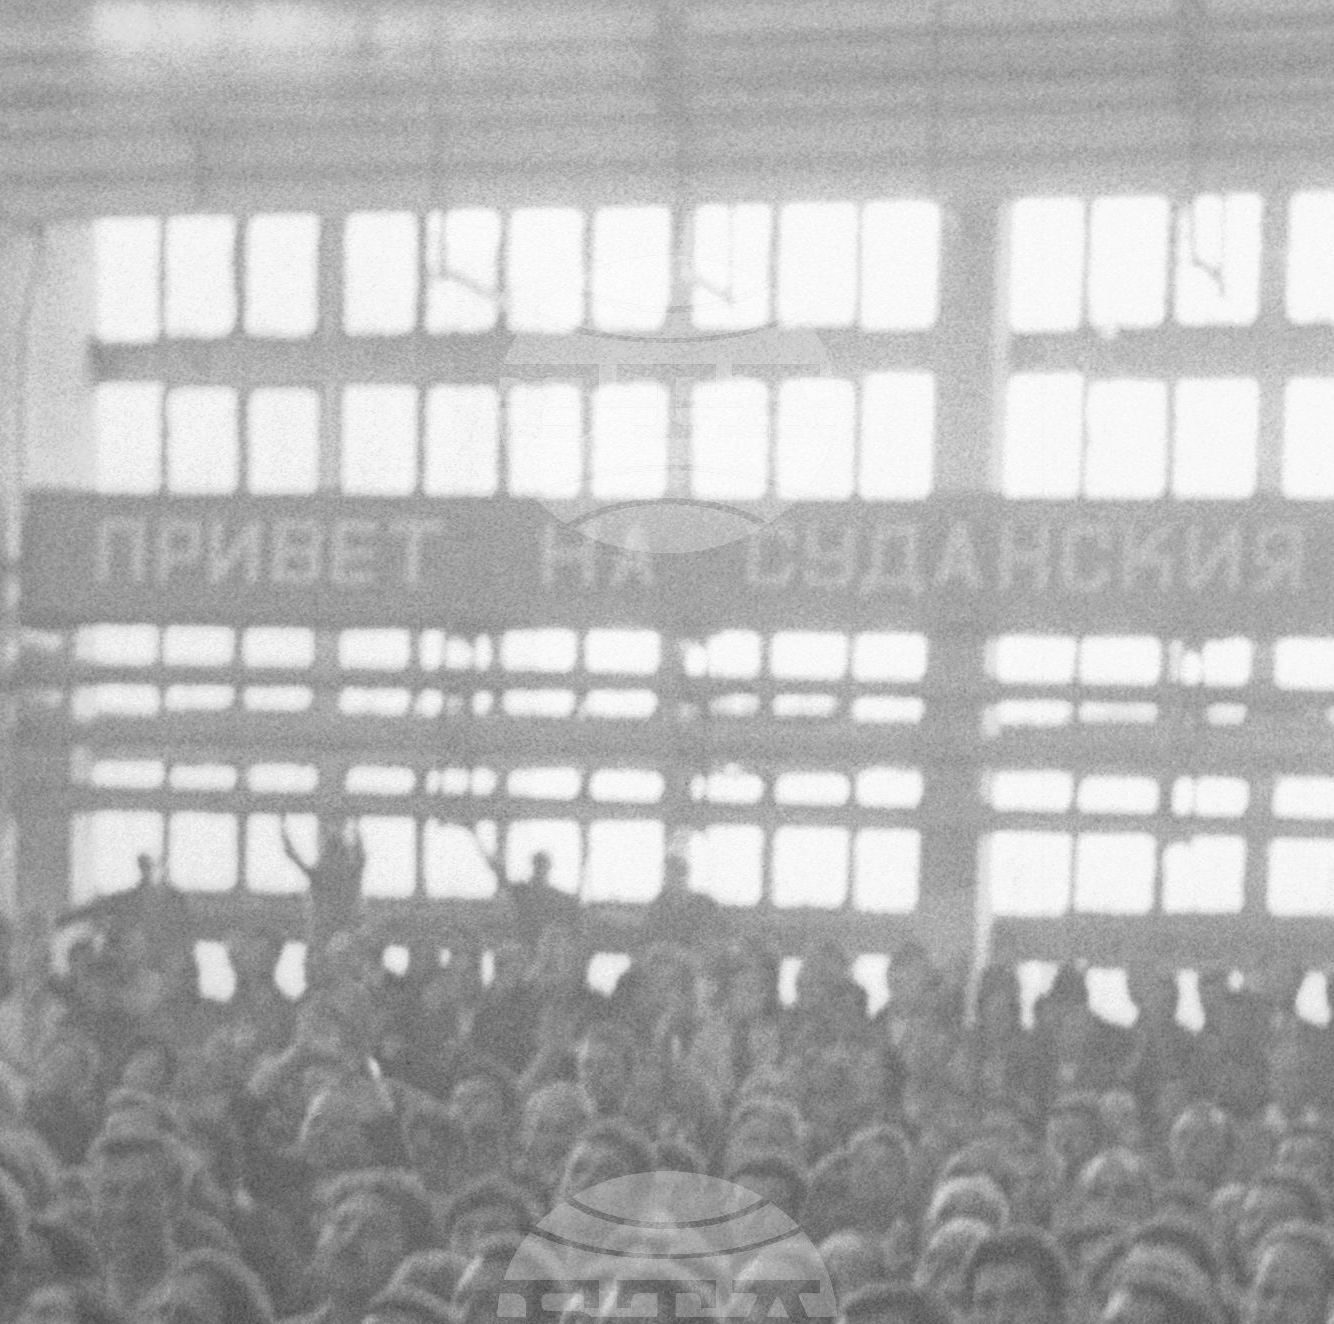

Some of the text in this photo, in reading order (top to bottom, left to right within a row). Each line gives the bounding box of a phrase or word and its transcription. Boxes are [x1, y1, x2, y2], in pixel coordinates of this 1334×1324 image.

[92, 515, 443, 588] ПРИВЕТ
[542, 520, 656, 590] НА
[745, 520, 1305, 594] СУДАНСКИЯ
